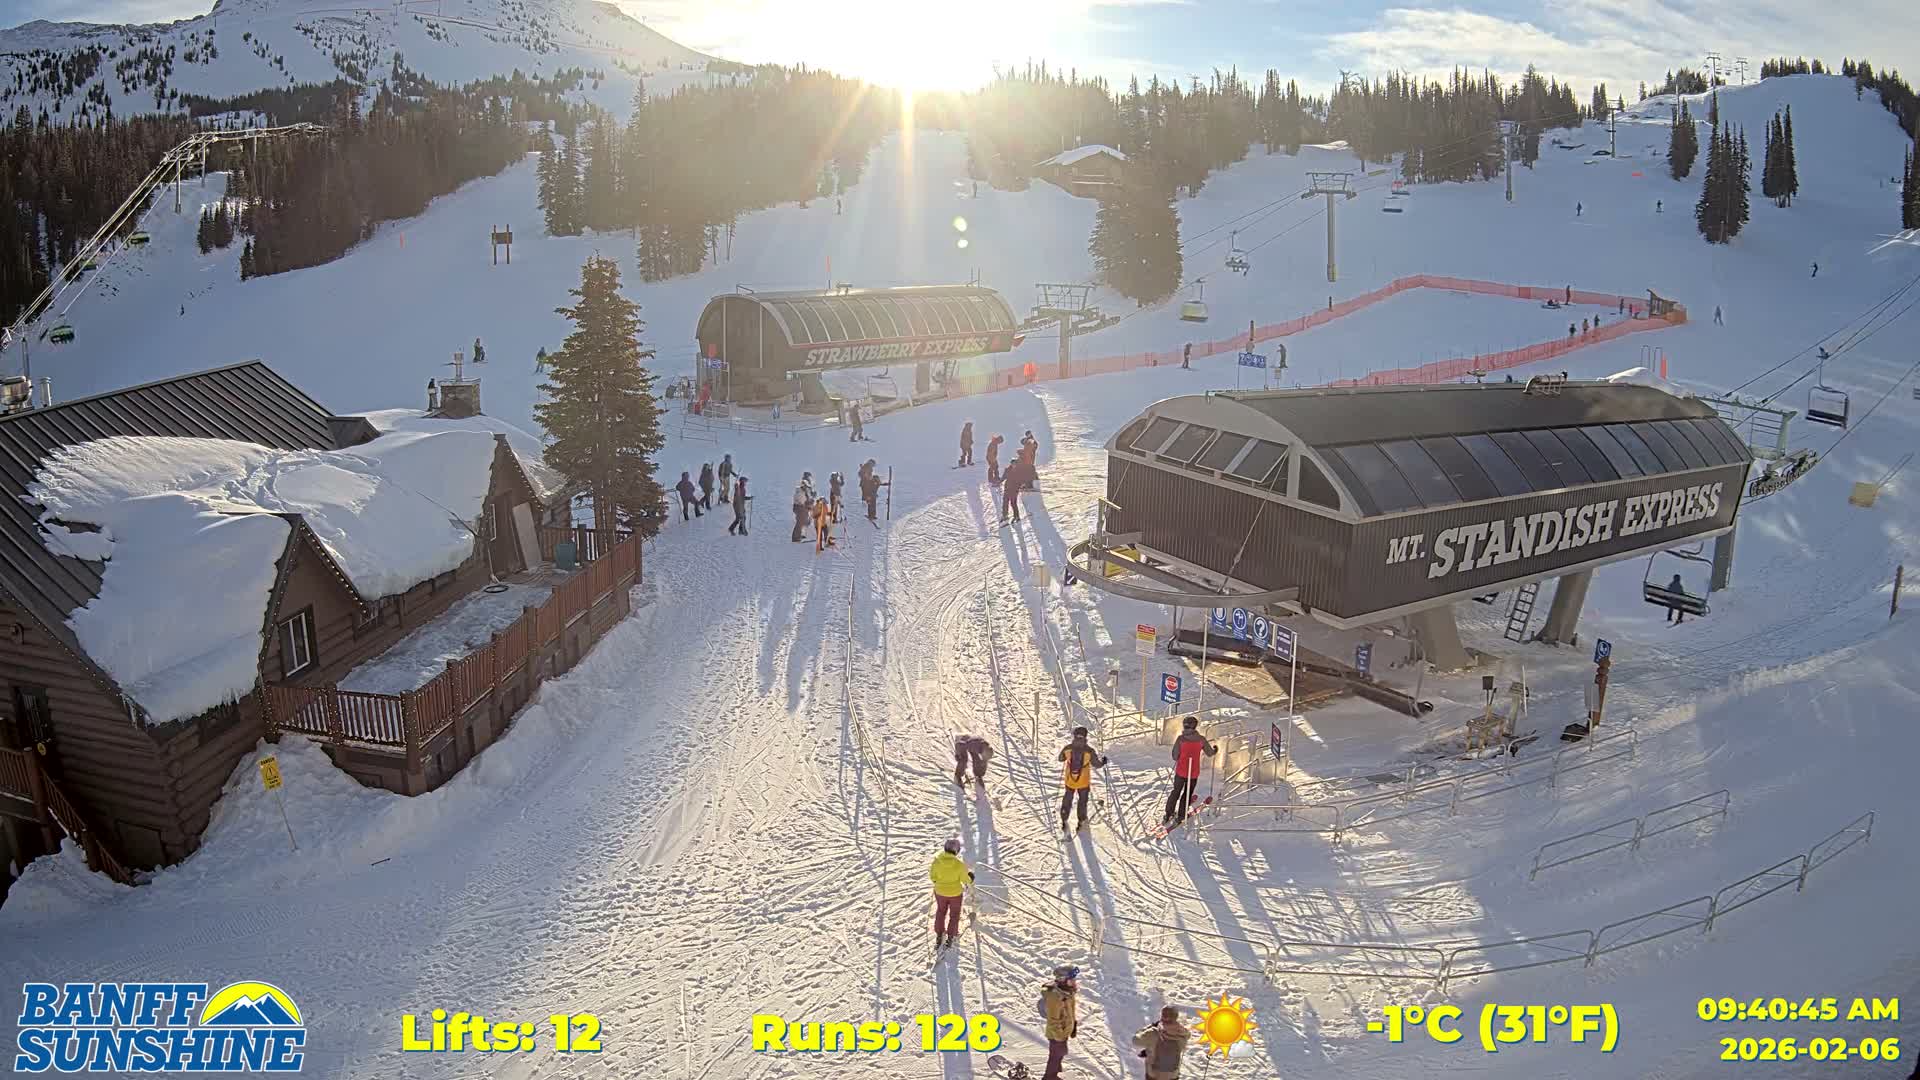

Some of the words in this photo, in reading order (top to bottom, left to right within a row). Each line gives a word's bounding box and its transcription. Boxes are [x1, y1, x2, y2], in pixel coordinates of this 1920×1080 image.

[805, 341, 920, 366] STRAWBERRY
[922, 336, 990, 356] EXPRESS
[1385, 533, 1426, 565] MT.
[1428, 499, 1619, 579] STANDISH
[1620, 482, 1723, 537] EXPRESS
